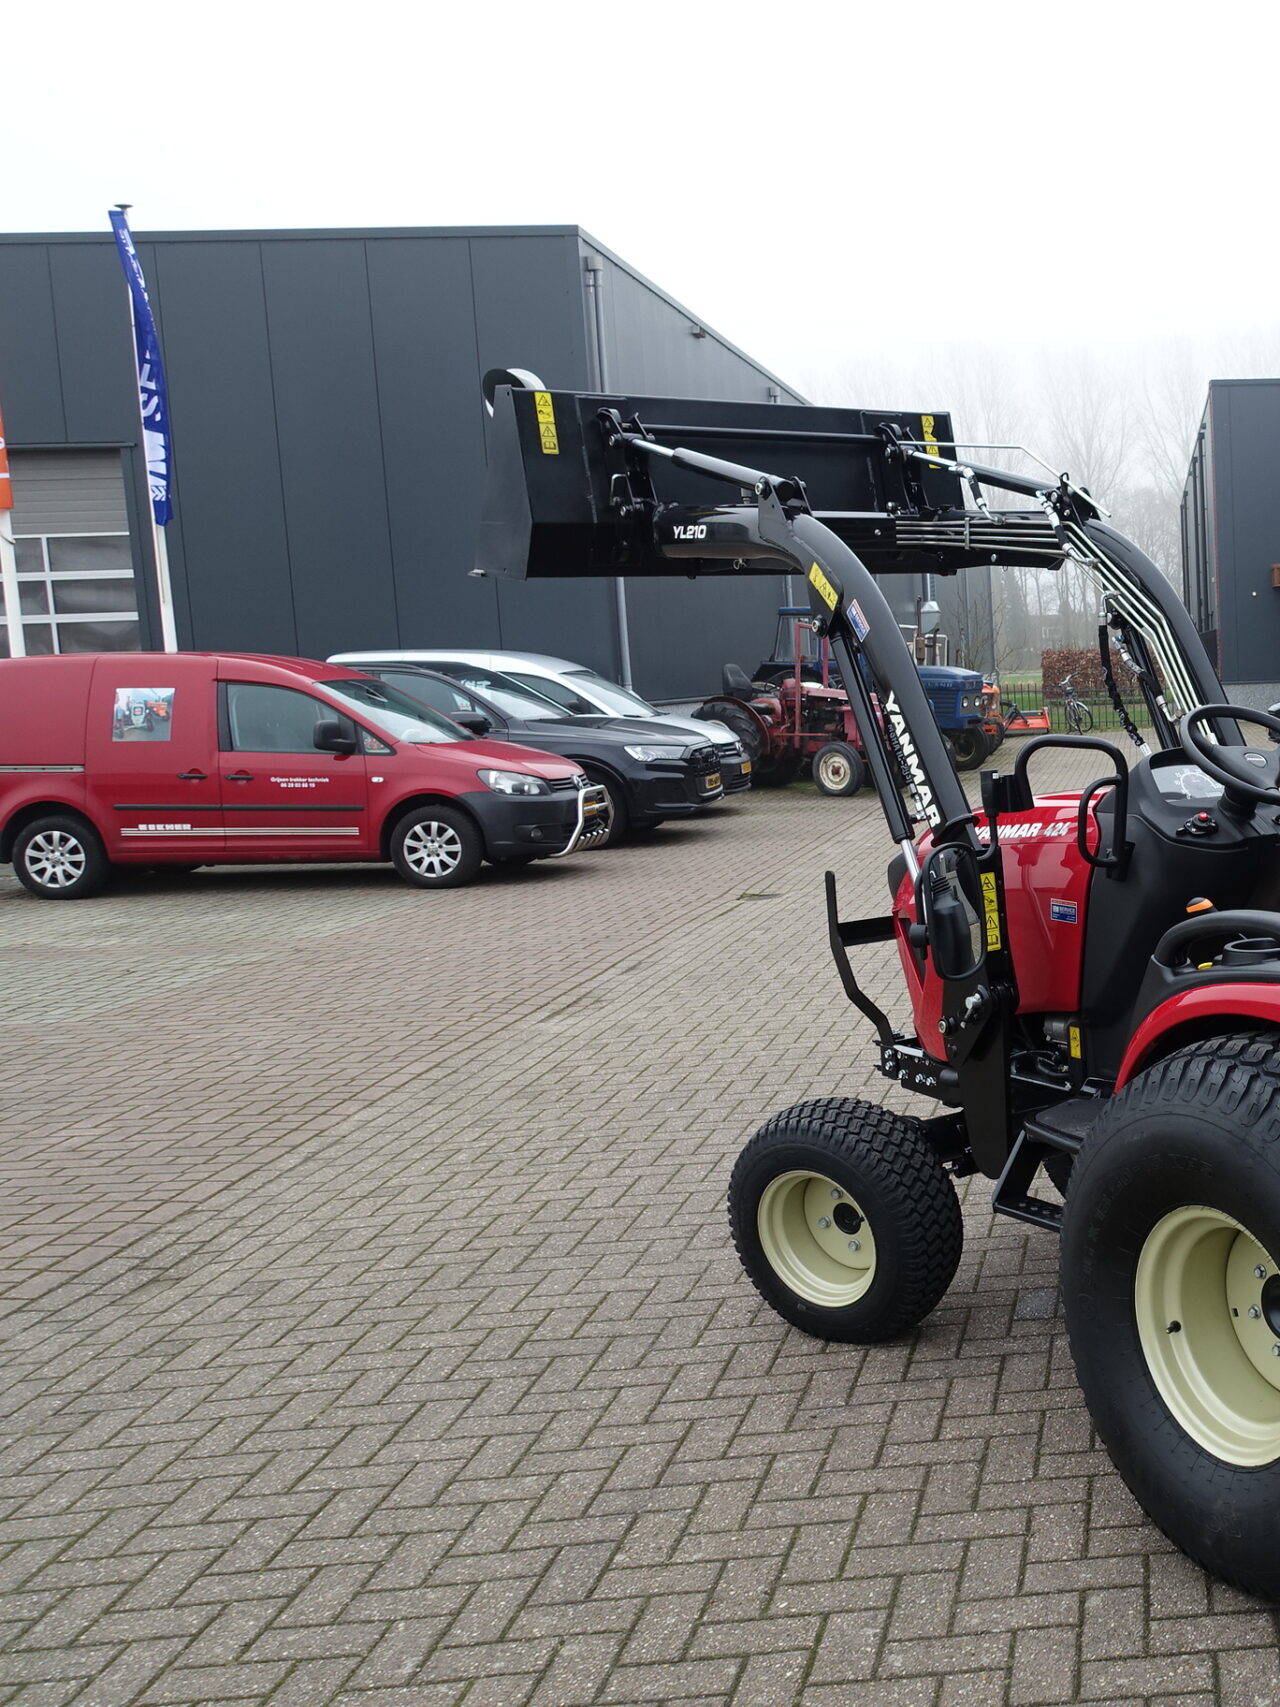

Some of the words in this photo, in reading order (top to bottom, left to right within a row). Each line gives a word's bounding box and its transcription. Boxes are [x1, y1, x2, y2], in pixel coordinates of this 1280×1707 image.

[673, 525, 707, 539] YL210
[885, 690, 942, 828] YANMAR
[1043, 821, 1072, 836] 424
